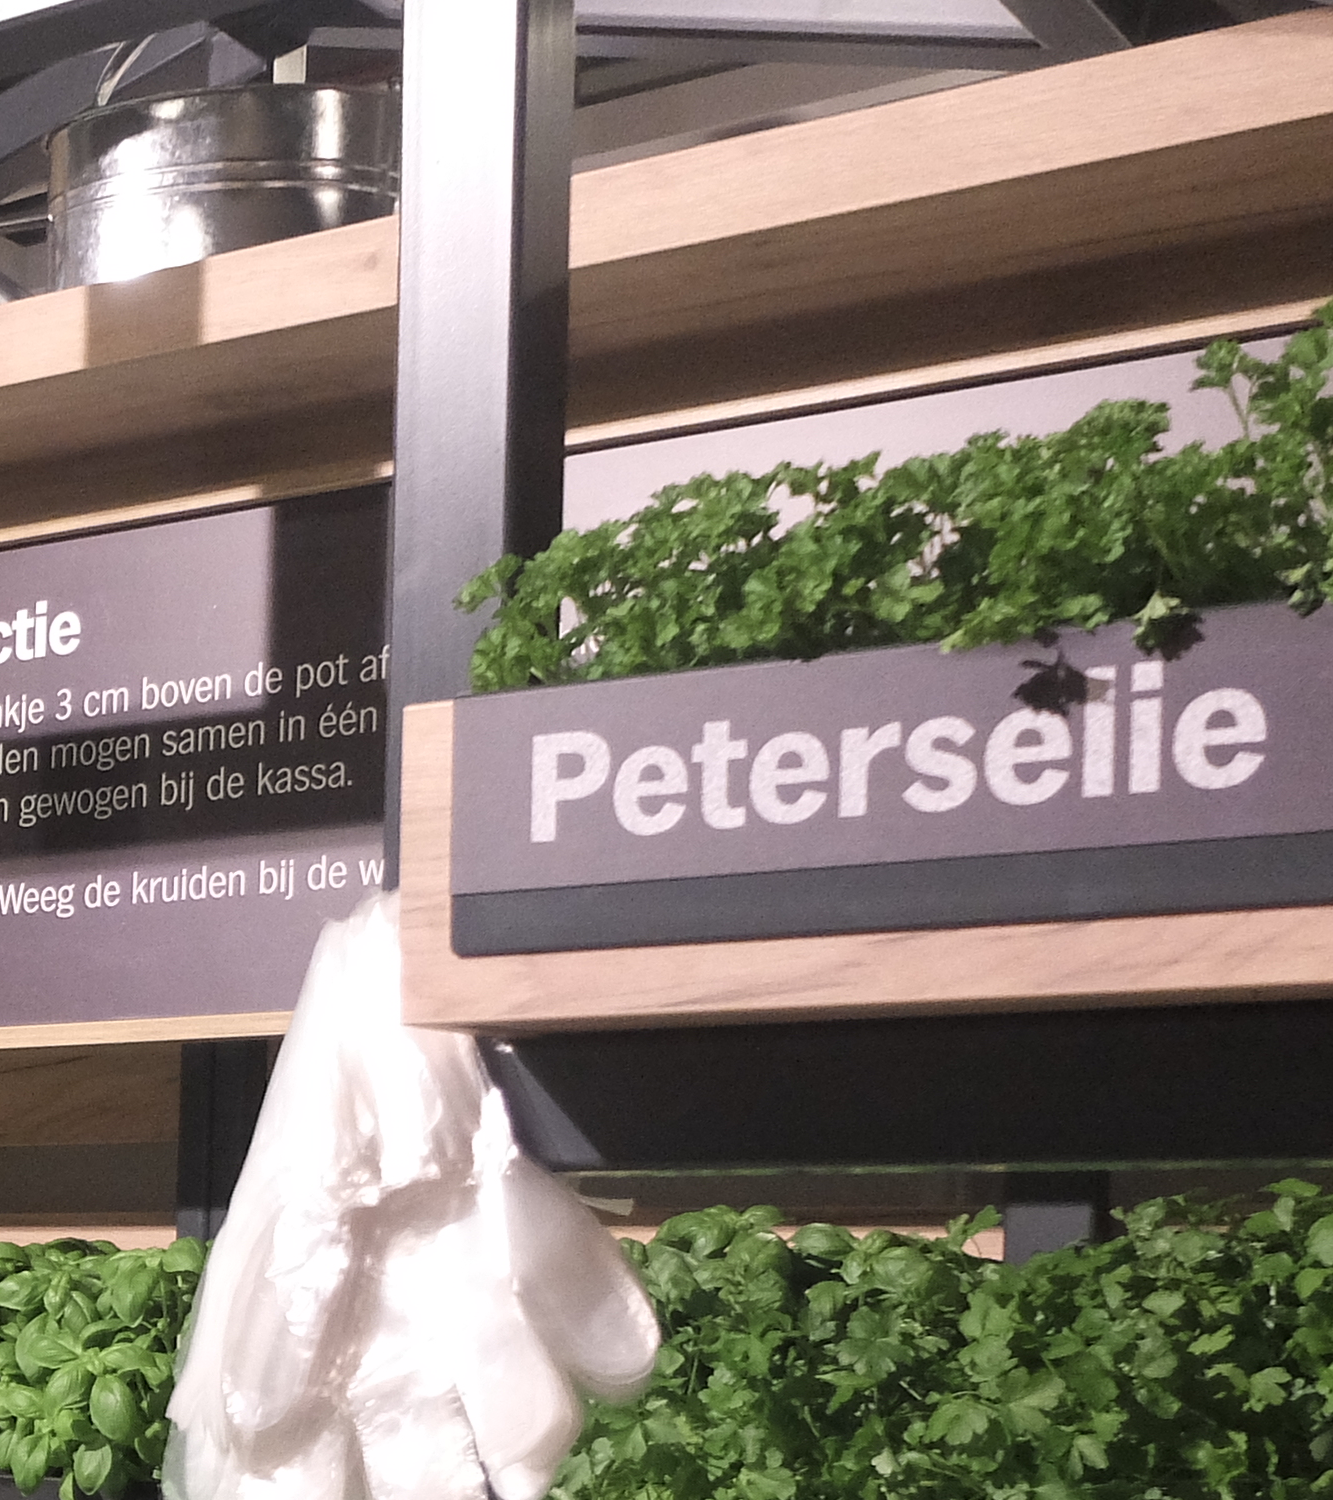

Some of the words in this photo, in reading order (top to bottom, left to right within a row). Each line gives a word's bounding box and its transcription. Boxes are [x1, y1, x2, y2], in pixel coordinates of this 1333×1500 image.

[55, 688, 73, 721] 3
[83, 686, 129, 717] cm
[141, 672, 232, 710] boven
[244, 662, 283, 697] de
[296, 654, 349, 698] pot
[359, 645, 391, 682] af
[50, 731, 151, 772] mogen
[162, 720, 266, 757] samen
[278, 711, 306, 743] in
[318, 702, 378, 739] één
[530, 659, 1268, 844] Peterselie
[18, 782, 147, 828] gewogen
[161, 771, 195, 810] bij
[207, 767, 245, 801] de
[257, 761, 353, 796] kassa.
[84, 875, 121, 909] de
[132, 866, 246, 904] kruiden
[259, 859, 295, 899] bij
[307, 855, 348, 891] de
